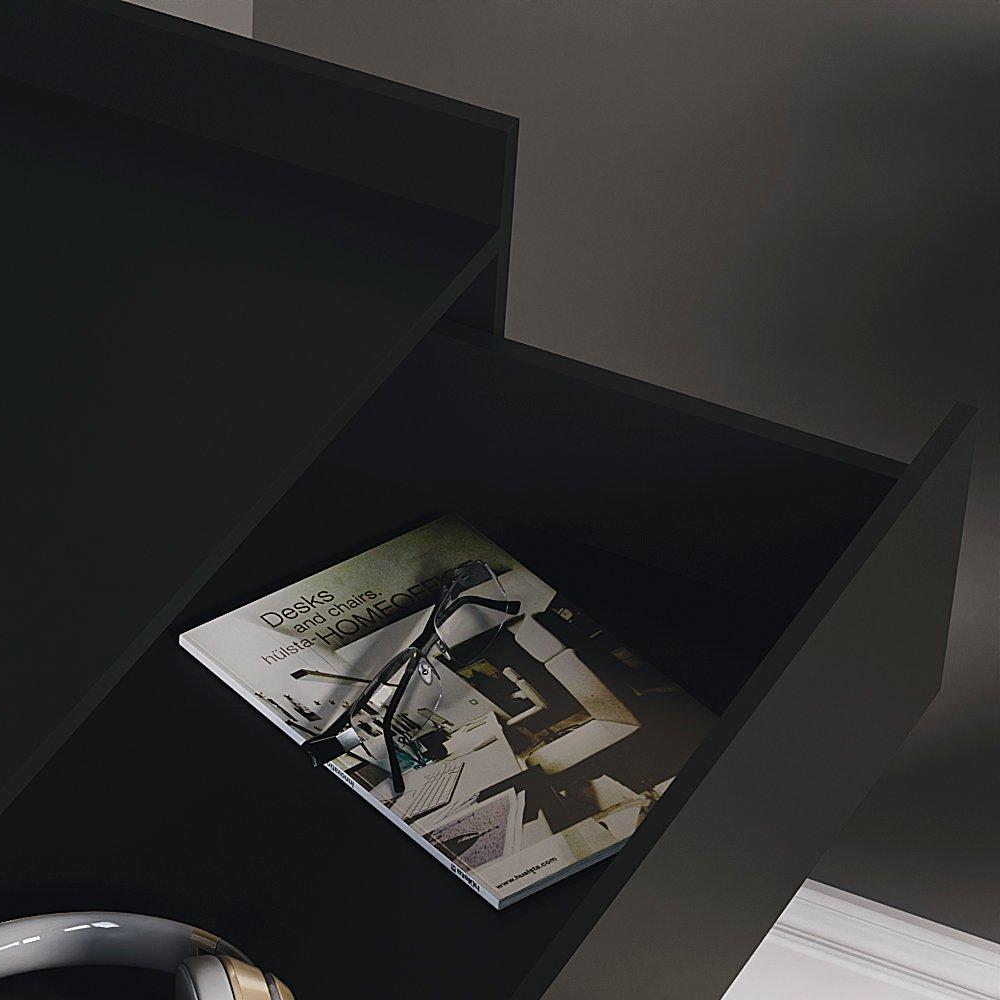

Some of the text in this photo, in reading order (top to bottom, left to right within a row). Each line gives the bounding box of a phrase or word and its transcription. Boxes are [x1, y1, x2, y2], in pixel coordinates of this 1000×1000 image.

[260, 590, 335, 628] Desks
[294, 589, 382, 633] and chairs.
